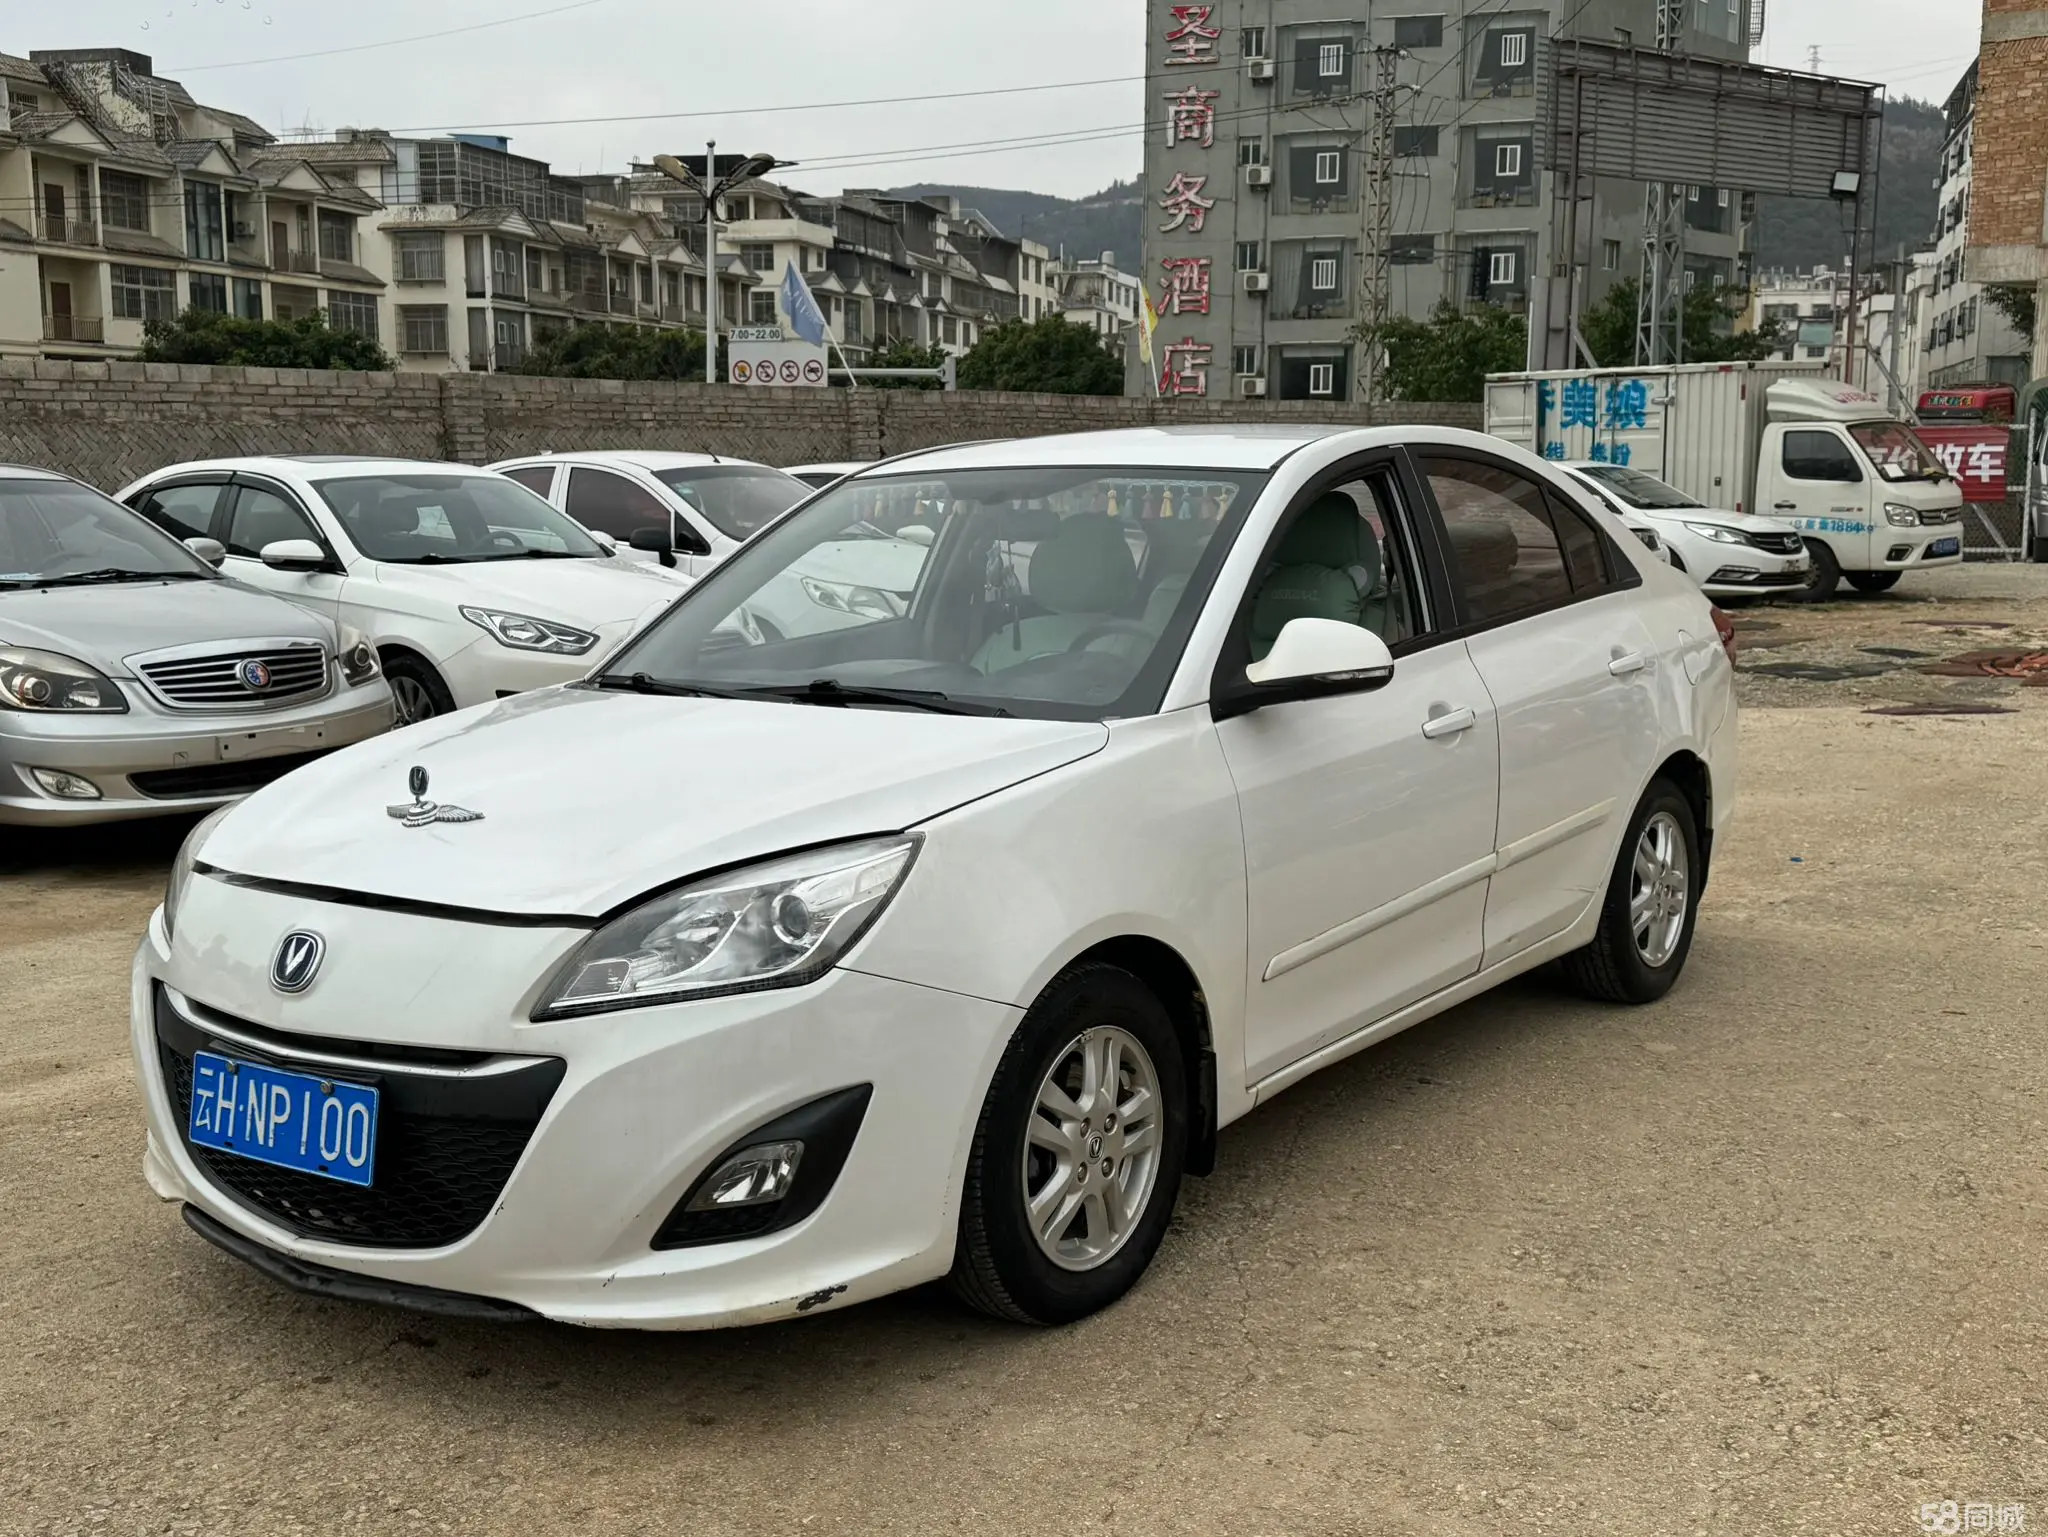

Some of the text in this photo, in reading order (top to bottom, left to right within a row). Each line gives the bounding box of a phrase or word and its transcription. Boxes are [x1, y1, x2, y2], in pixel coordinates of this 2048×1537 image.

[1157, 4, 1222, 397] 圣商务酒店
